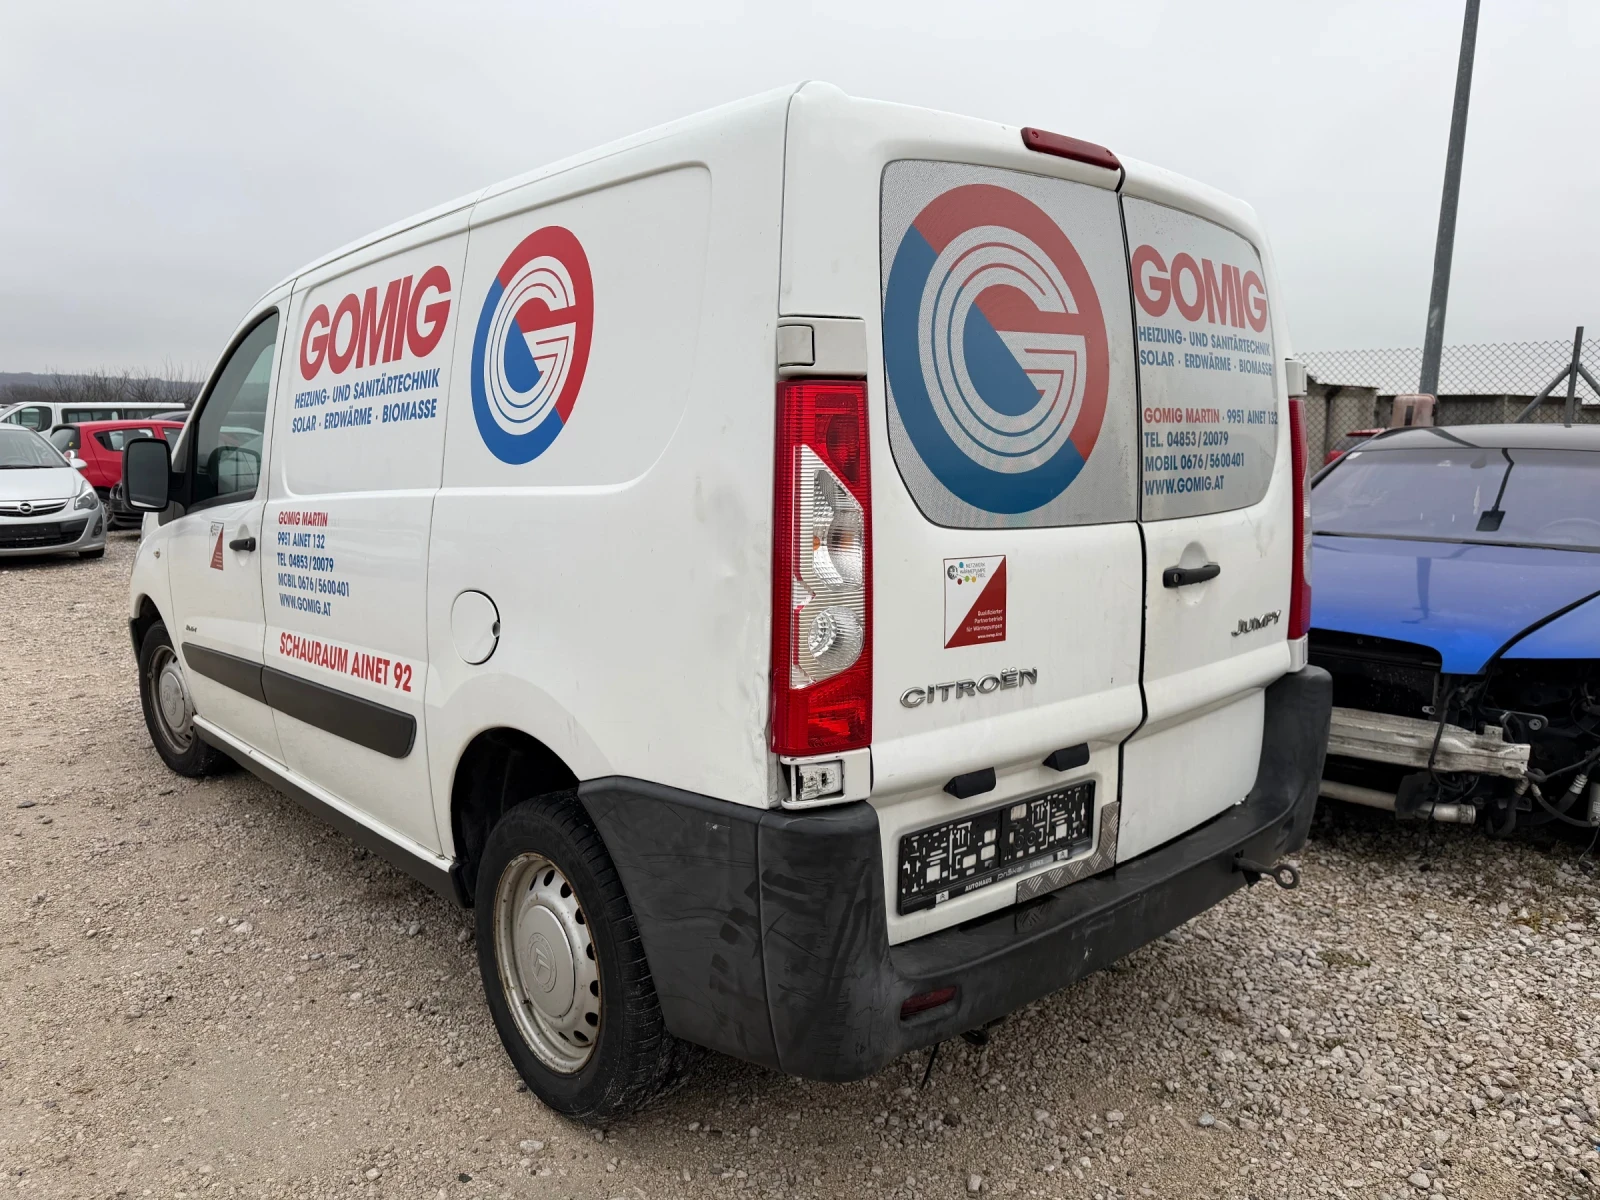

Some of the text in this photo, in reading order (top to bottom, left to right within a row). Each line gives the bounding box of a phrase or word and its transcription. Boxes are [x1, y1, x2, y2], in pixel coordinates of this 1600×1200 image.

[1131, 244, 1267, 333] GOMIG
[299, 265, 452, 381] GOMIG
[1138, 325, 1271, 357] HEIZUNG- UND SANITÄRTECHNIK
[1140, 350, 1272, 377] SOLAR ERDWÄRME BIOMASSE
[294, 367, 440, 410] HEIZUNG- UND SANITÄRTECHNIK
[292, 398, 437, 434] SOLAR ERDWÄRME BIOMASSE
[1144, 407, 1278, 425] GOMIG MARTIN 9951 AINET 132
[1144, 431, 1164, 448] TEL.
[1145, 455, 1178, 472] MOBIL
[1145, 475, 1225, 496] WWW.GOMIG.AT
[278, 511, 328, 527] GOMIG MARTIN
[277, 531, 325, 549] 9951 AINET 132
[279, 592, 332, 617] WWW.GOMIG.AT
[1231, 610, 1281, 637] JUMPY
[279, 632, 413, 693] SCHAURAUM AINET 92
[900, 667, 1037, 708] CITROËN
[964, 877, 993, 892] AUTOHAUS
